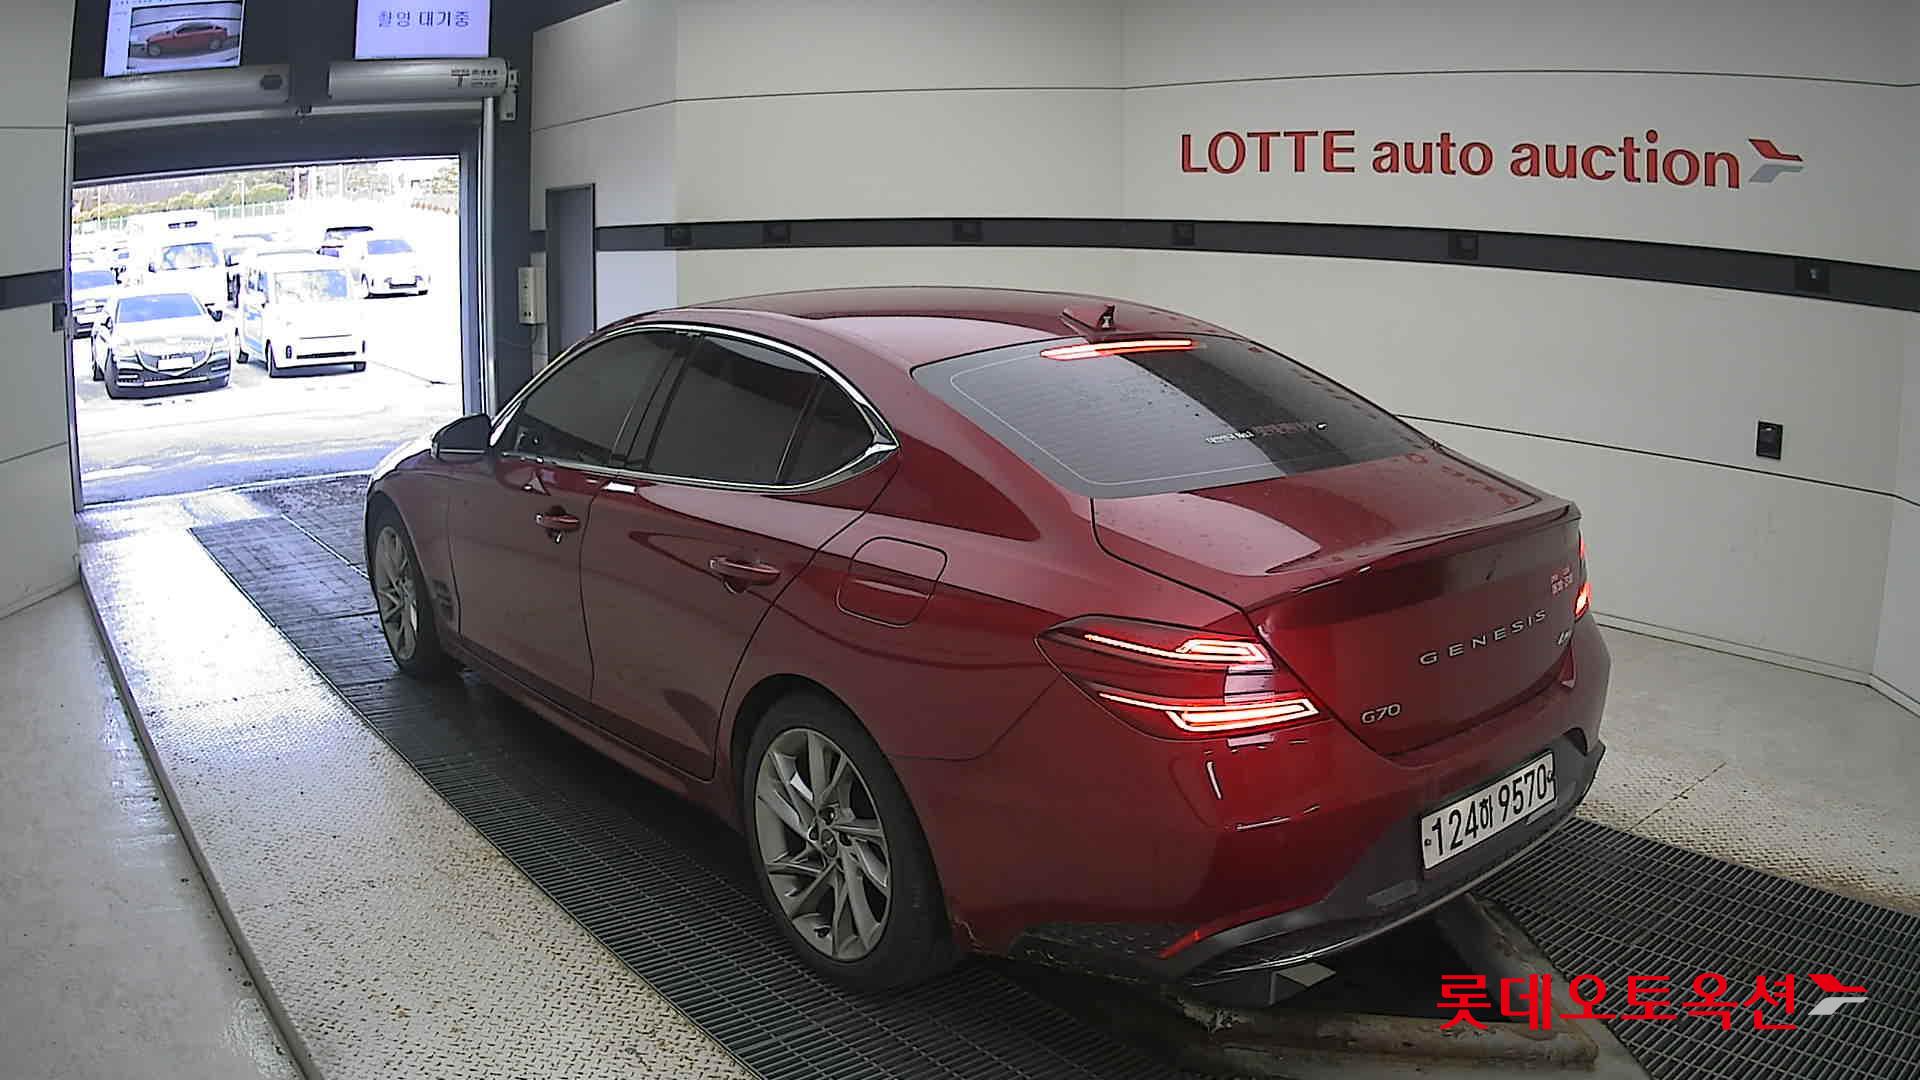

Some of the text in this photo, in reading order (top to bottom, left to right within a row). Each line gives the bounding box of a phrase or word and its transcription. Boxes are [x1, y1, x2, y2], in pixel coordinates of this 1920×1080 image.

[1180, 129, 1741, 189] LOTTE auto auction
[1419, 608, 1546, 666] GENESIS
[1361, 703, 1401, 724] G70
[1498, 763, 1547, 823] 9570
